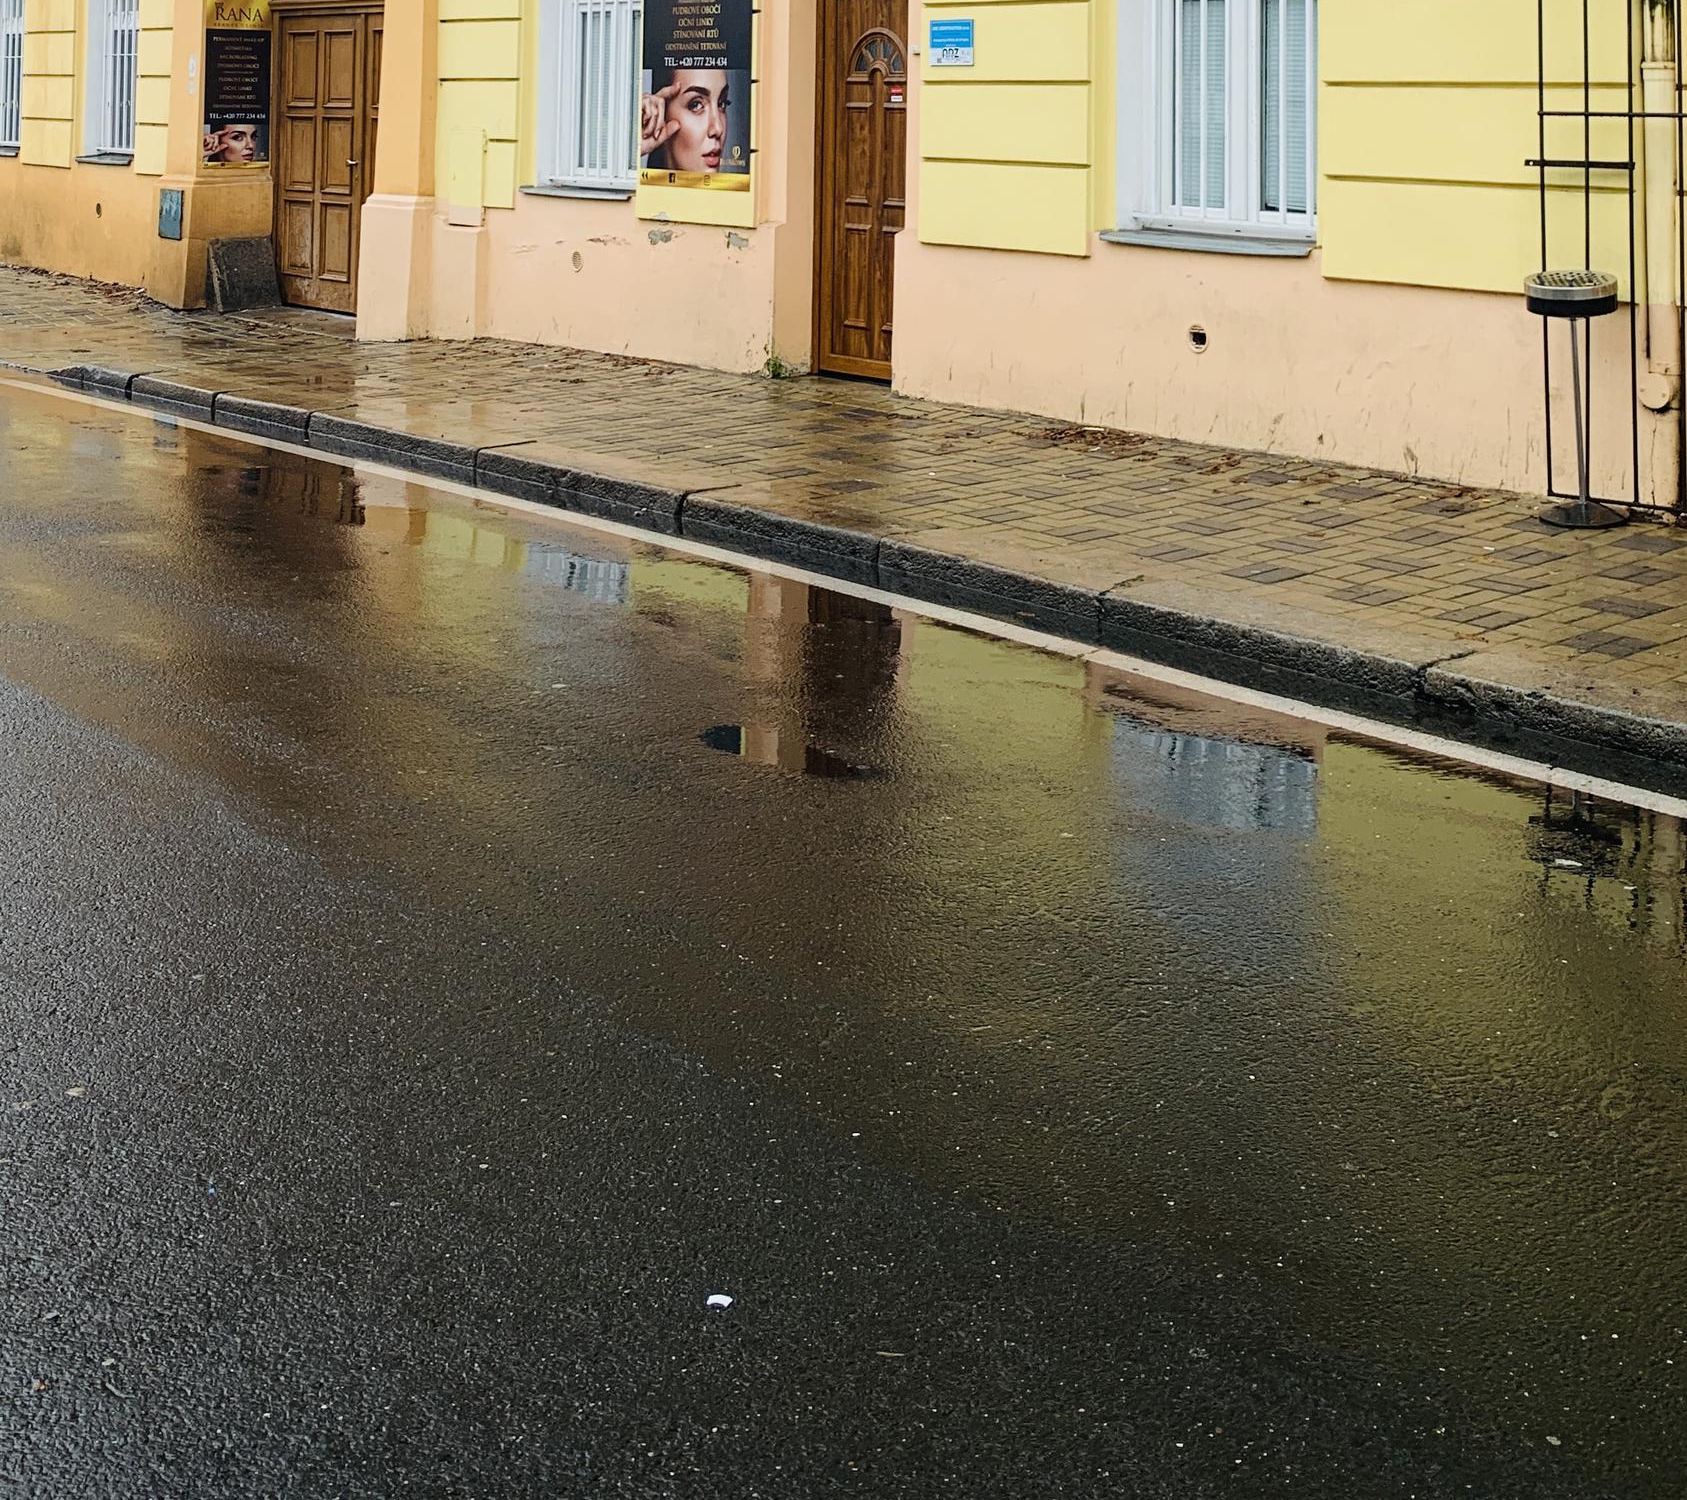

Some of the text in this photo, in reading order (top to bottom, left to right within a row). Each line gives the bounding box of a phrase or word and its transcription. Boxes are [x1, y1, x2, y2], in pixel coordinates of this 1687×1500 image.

[664, 57, 728, 67] TEL: +420 777 234 434
